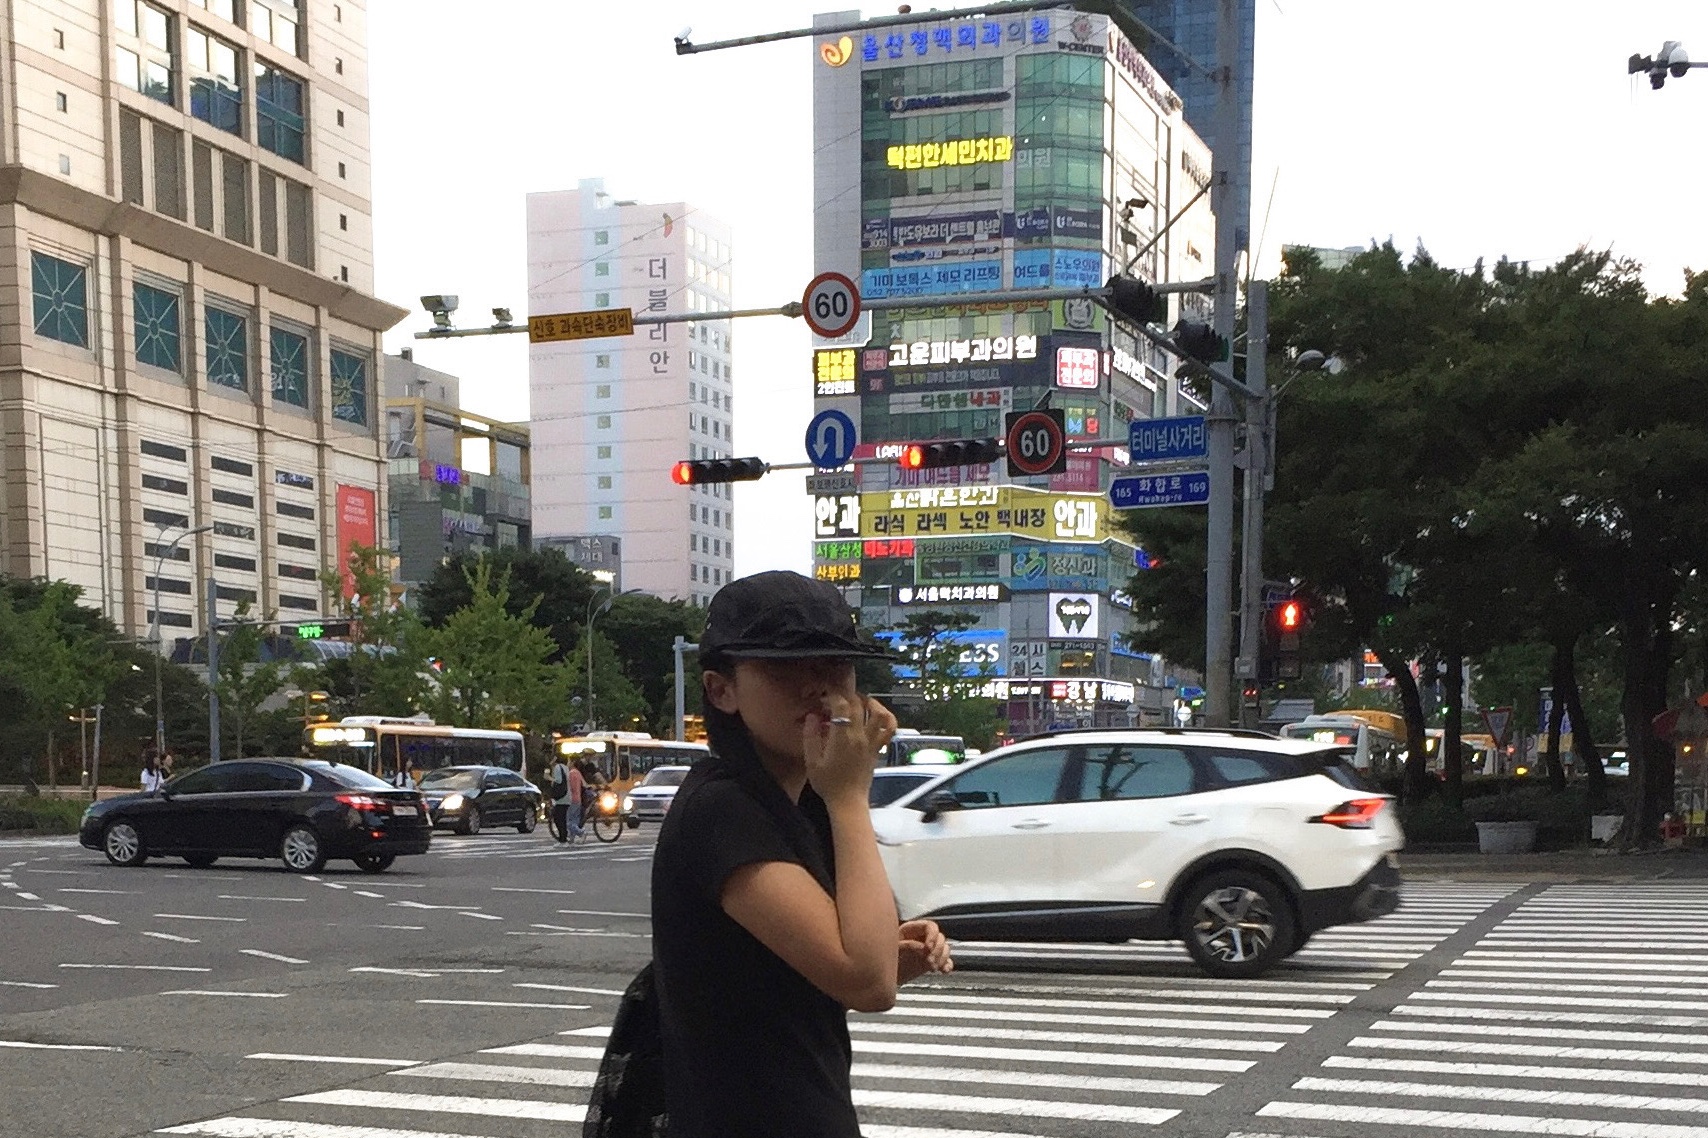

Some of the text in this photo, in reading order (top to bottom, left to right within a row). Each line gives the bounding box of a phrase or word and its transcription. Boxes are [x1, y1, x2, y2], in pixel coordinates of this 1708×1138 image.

[815, 291, 848, 319] 60
[534, 314, 629, 338] 신호 과속단속장비
[888, 335, 1037, 367] 고운피부과의원
[1021, 429, 1050, 457] 60
[1132, 424, 1205, 454] 터미널사거리
[1115, 477, 1206, 499] 165 화합로 169
[815, 496, 861, 536] 안과
[874, 508, 1046, 534] 라식 라섹 노안 백내장
[1053, 499, 1098, 538] 안과
[816, 563, 861, 581] 산부인과
[1053, 554, 1097, 576] 정신과
